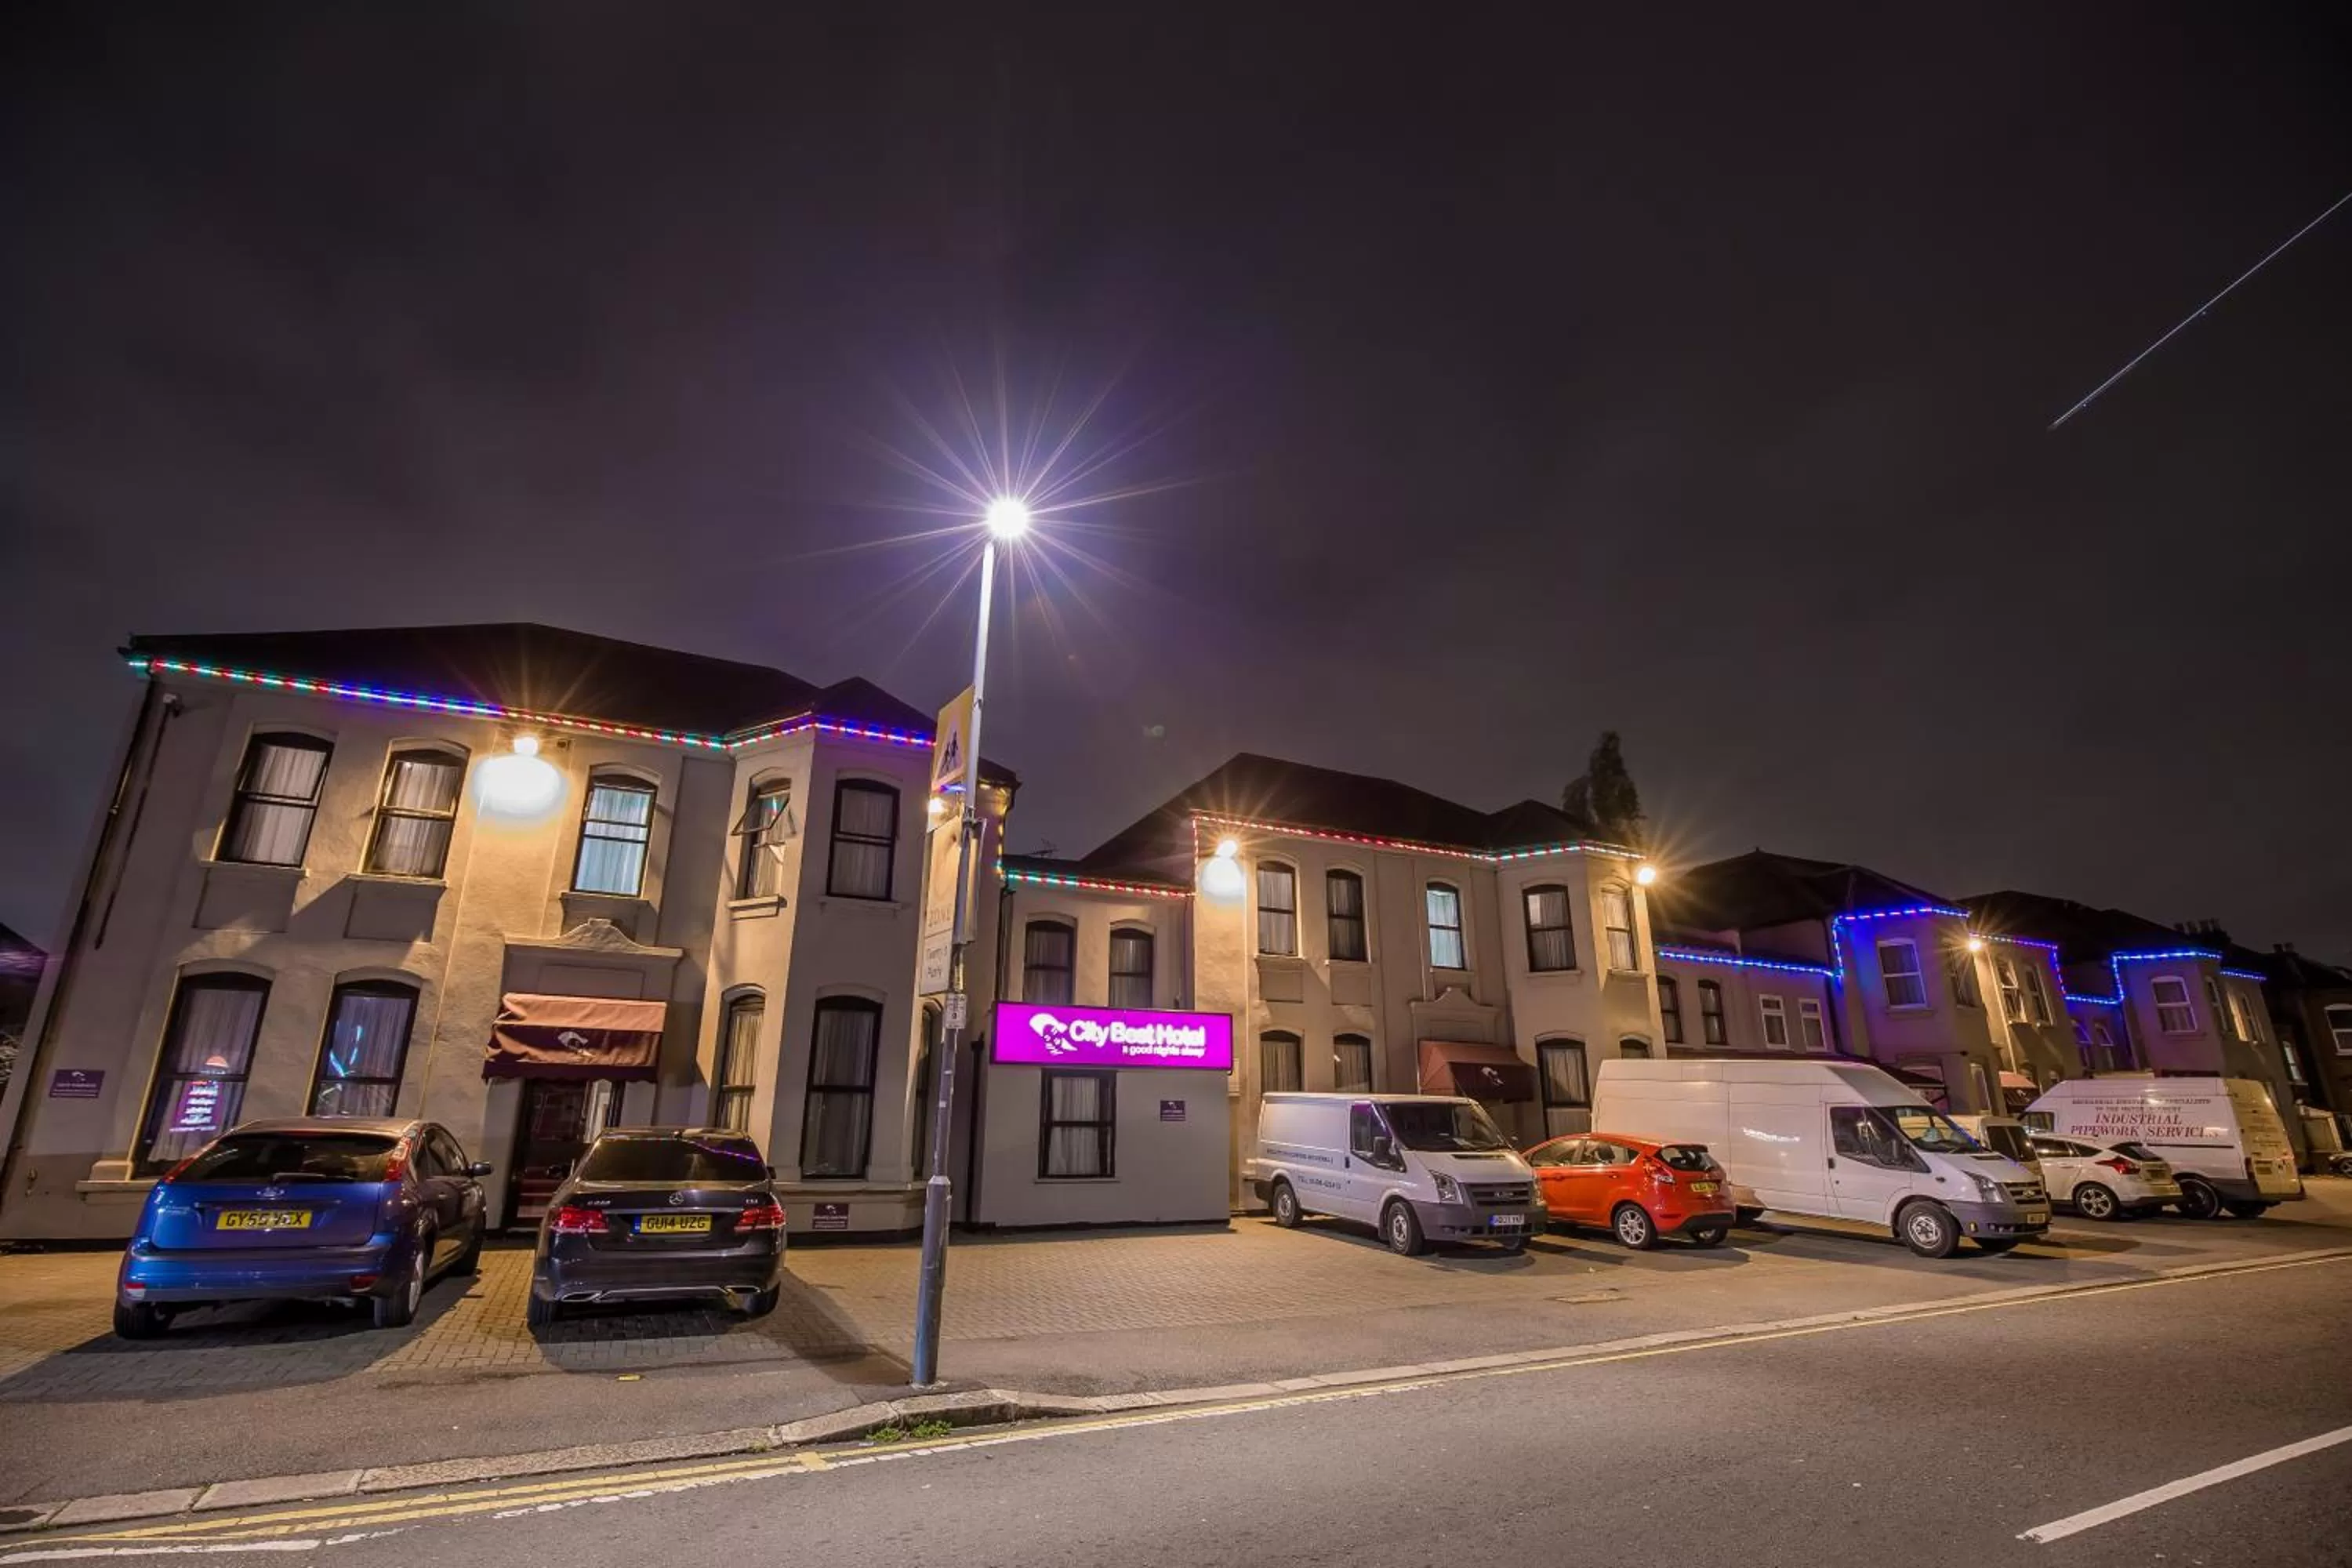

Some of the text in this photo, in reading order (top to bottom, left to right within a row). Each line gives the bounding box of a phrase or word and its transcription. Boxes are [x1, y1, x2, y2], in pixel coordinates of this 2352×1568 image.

[1069, 1019, 1206, 1047] City Best Hotel
[1129, 1046, 1152, 1057] good
[2096, 1113, 2182, 1124] INDUSTRIAL
[2071, 1125, 2139, 1137] PIPEWORK
